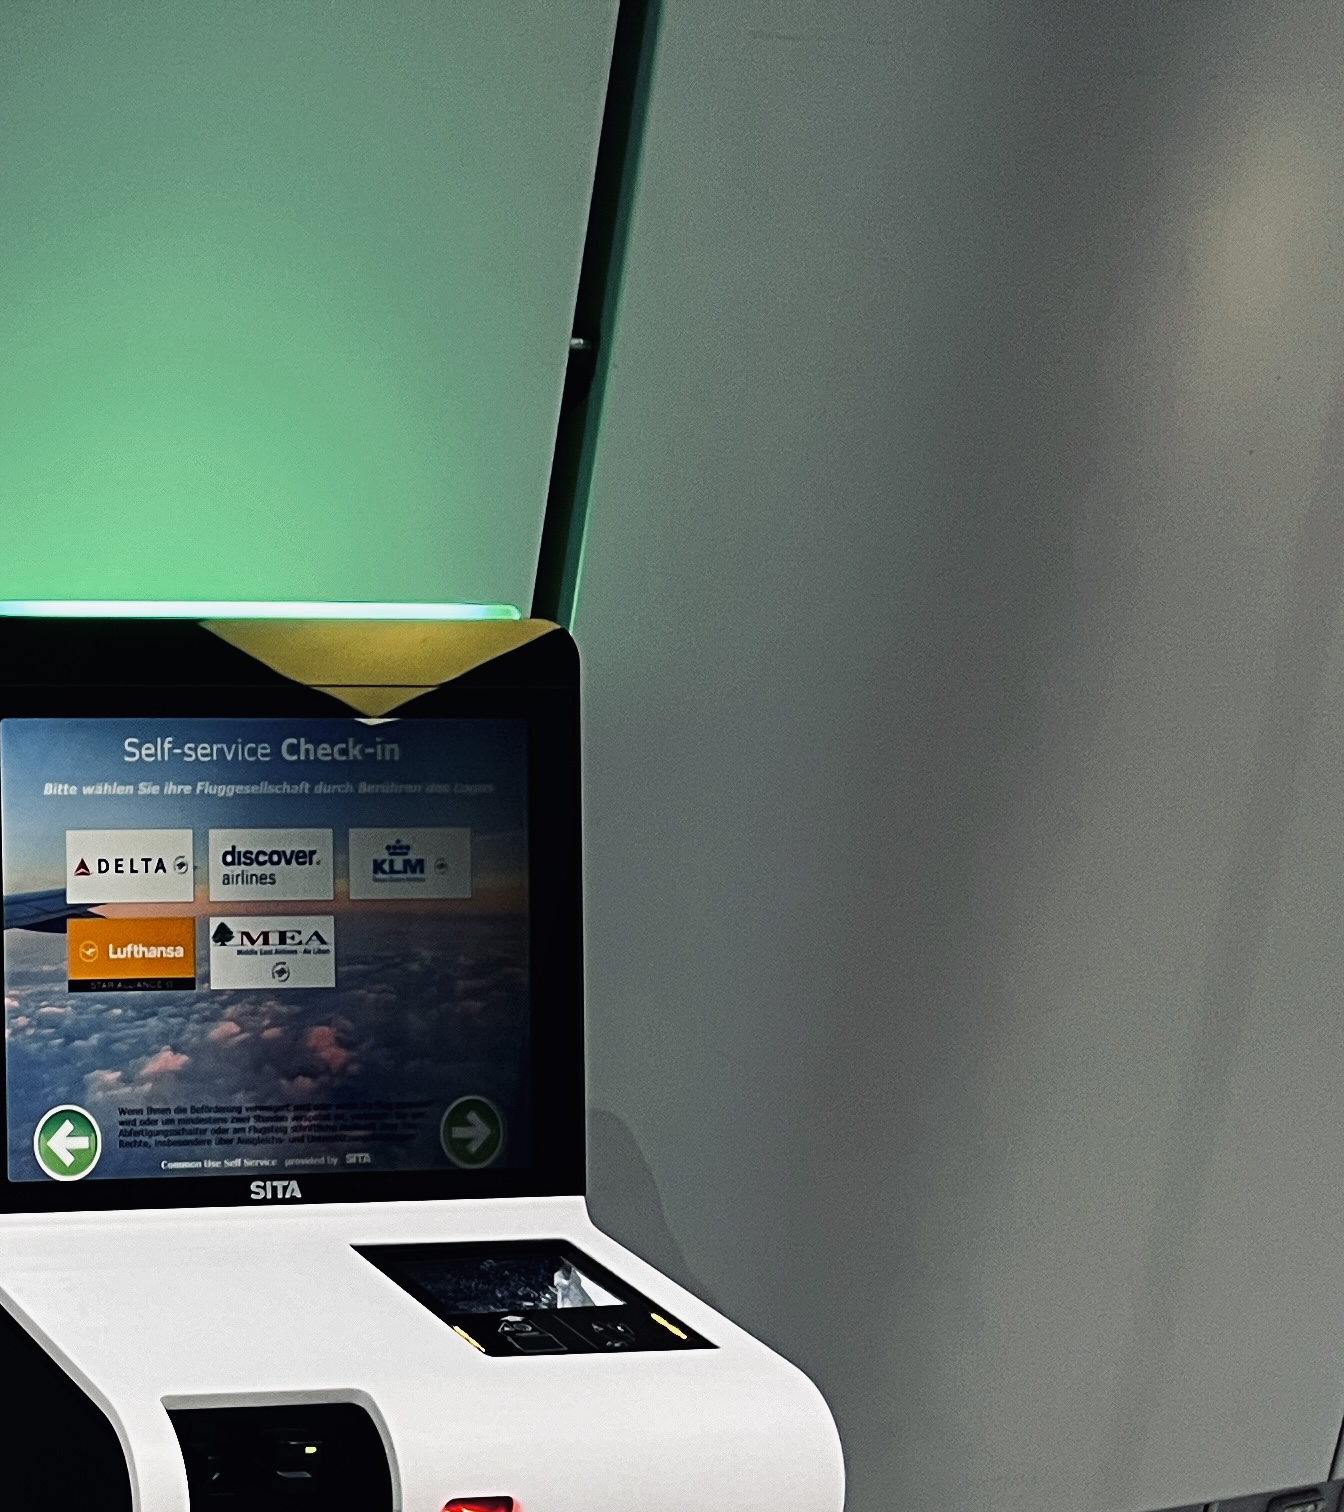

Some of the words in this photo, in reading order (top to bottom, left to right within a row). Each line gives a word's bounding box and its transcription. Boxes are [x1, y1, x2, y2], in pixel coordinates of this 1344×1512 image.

[123, 737, 271, 762] Self-service
[280, 737, 400, 761] Check-in
[43, 782, 78, 795] Bitte
[82, 781, 133, 795] wählen
[138, 781, 160, 795] Sie
[163, 781, 192, 795] ihre
[196, 781, 311, 797] Fluggesellschaft
[314, 780, 354, 794] durch
[98, 857, 167, 874] DELTA
[372, 858, 425, 875] KLM
[222, 870, 276, 885] airlines
[239, 930, 327, 947] MEA
[109, 943, 184, 959] Lufthansa
[345, 1153, 371, 1164] SITA
[250, 1180, 302, 1200] SITA
